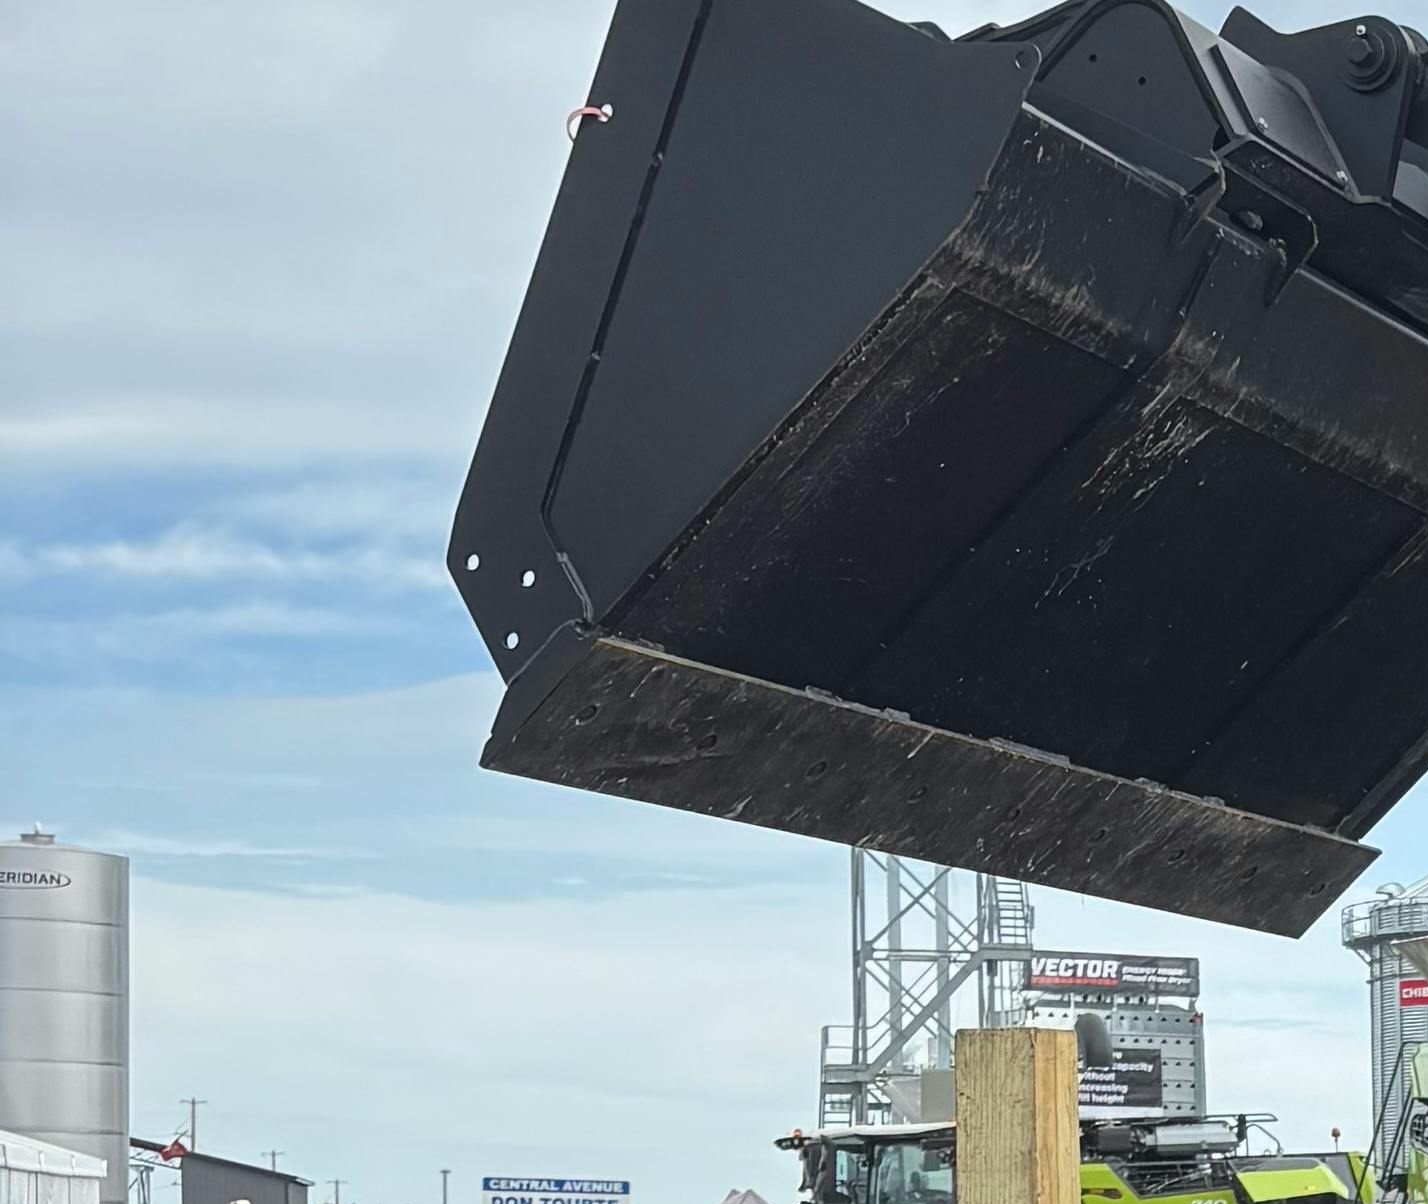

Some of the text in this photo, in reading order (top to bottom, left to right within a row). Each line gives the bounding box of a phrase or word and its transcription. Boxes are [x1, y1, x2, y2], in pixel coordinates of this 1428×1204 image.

[0, 871, 61, 885] ERIDIAN
[1031, 957, 1119, 978] VECTOR
[489, 1179, 624, 1193] CENTRAL AVENUE
